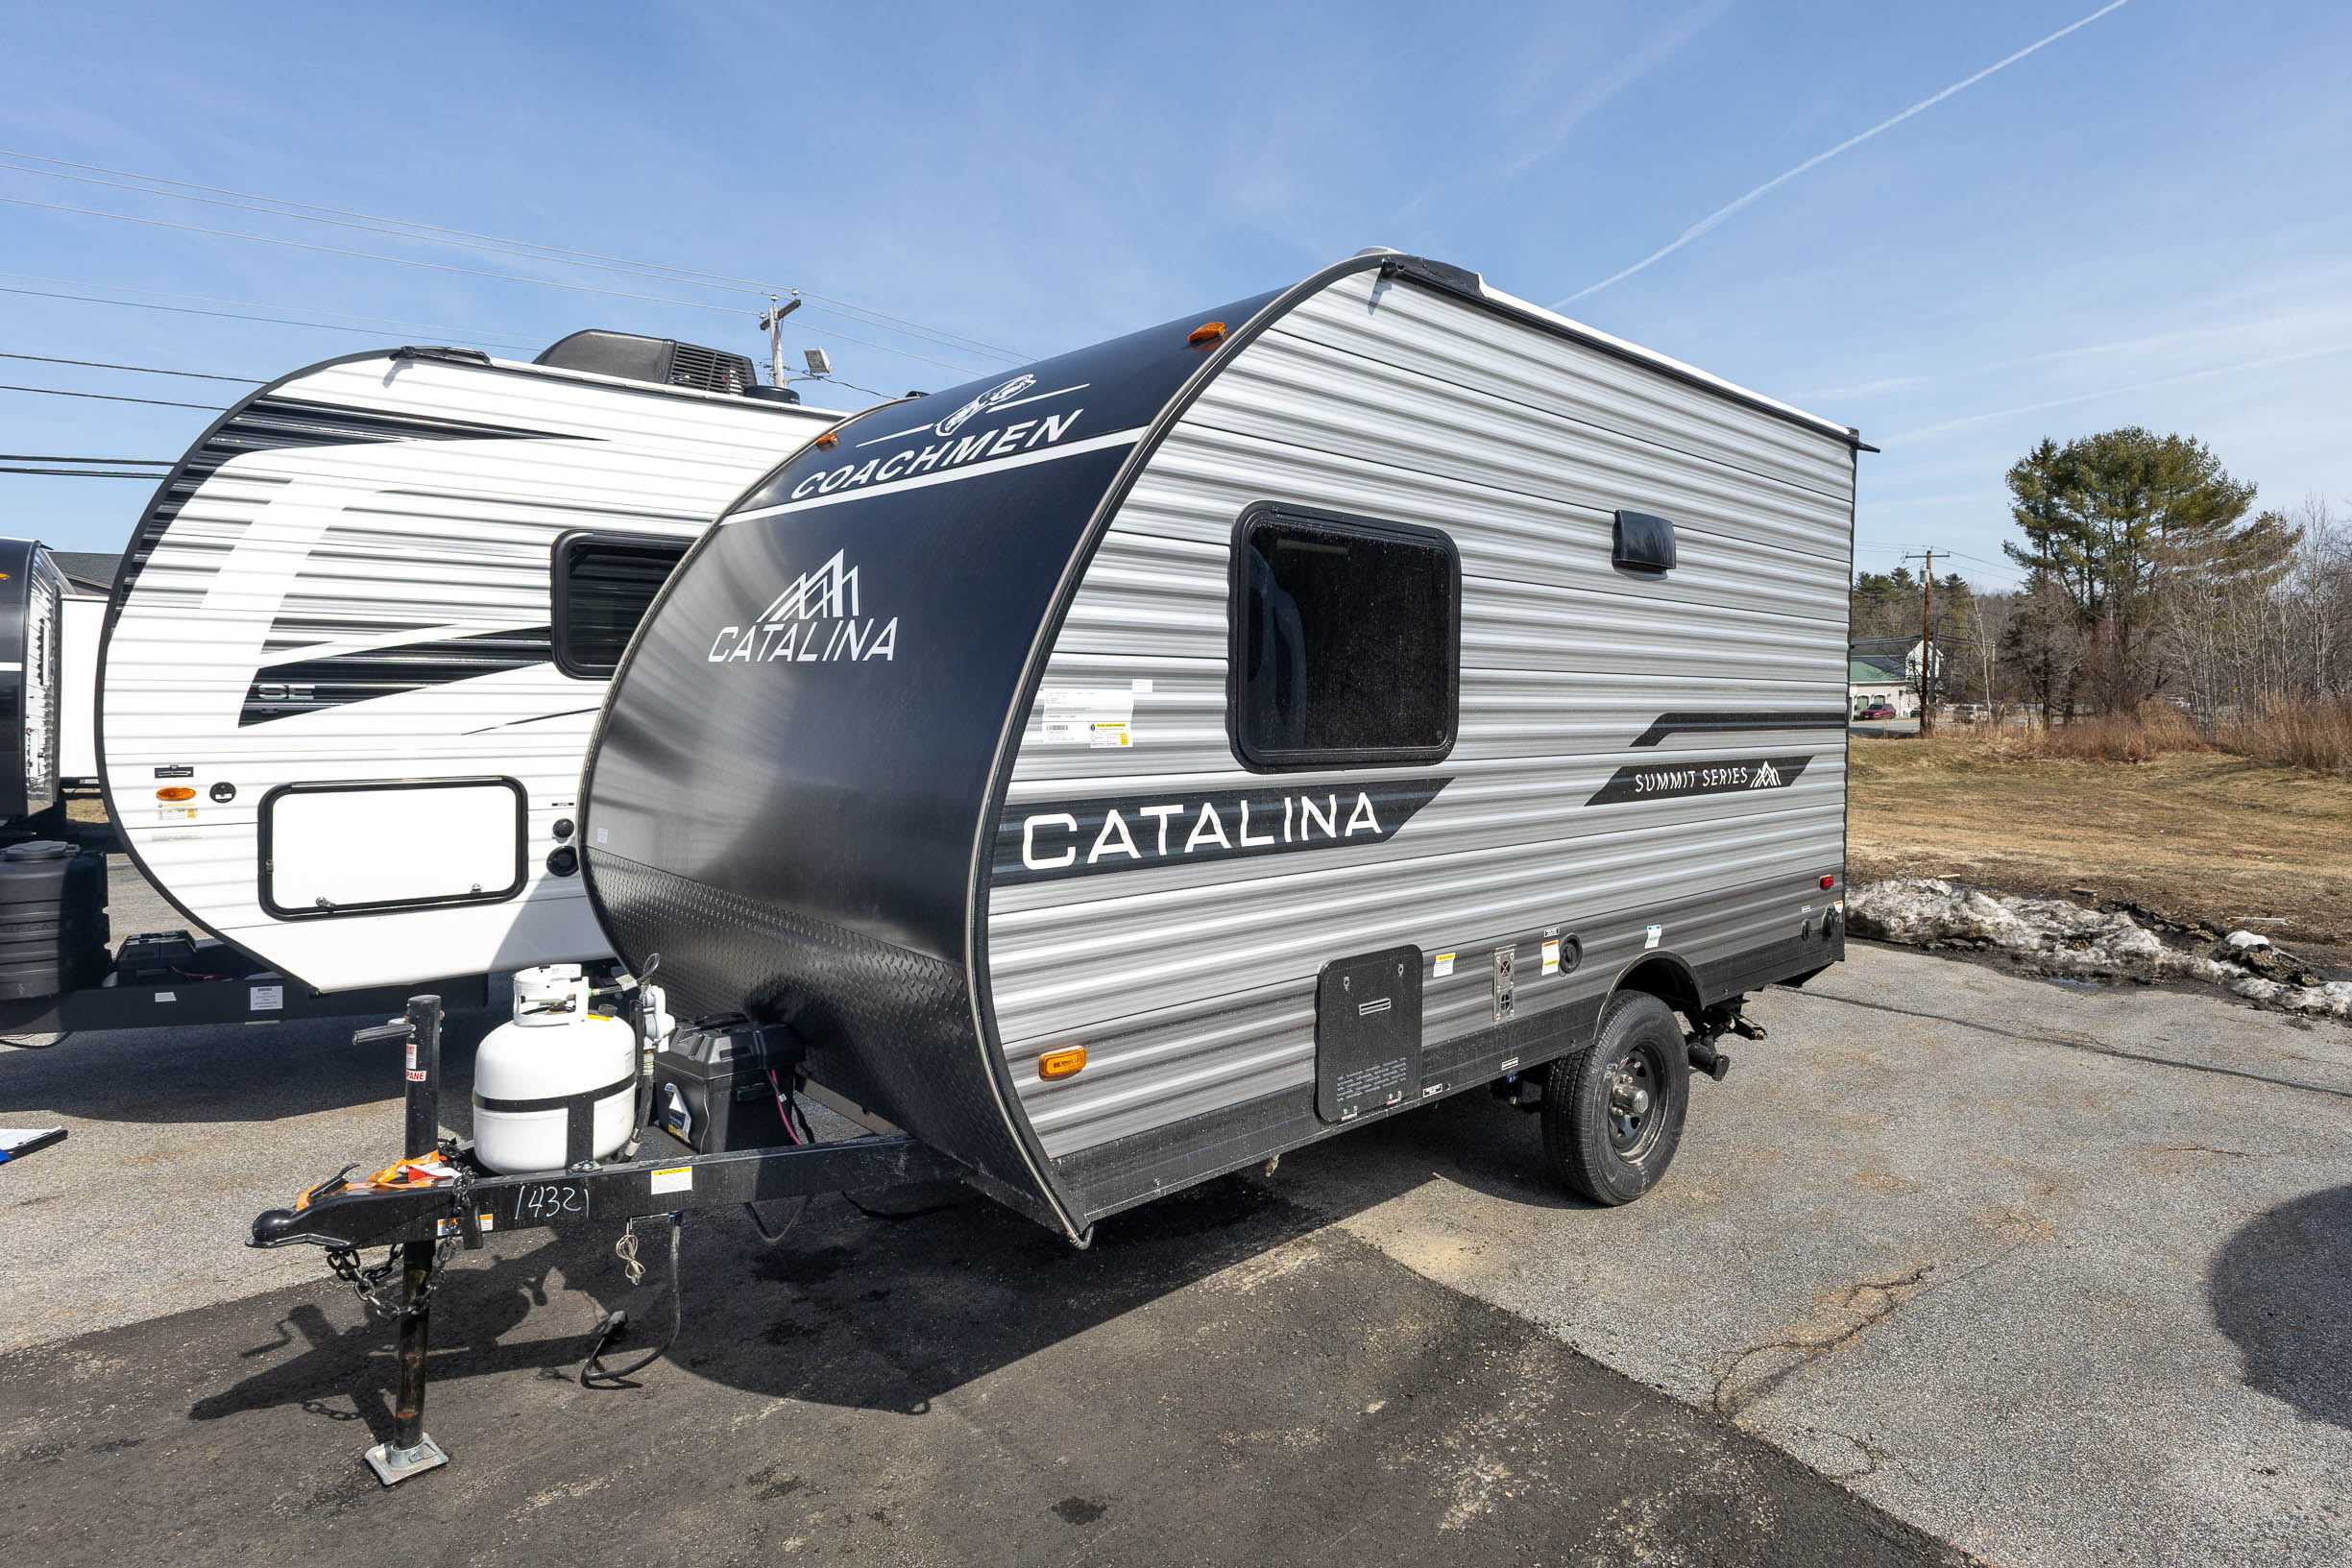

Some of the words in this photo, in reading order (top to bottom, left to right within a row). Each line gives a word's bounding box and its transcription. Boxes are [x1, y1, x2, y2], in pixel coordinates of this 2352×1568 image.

[790, 408, 1085, 500] COACHMEN
[707, 615, 899, 663] CATALINA
[1635, 770, 1696, 793] SUMMIT
[1702, 766, 1748, 787] SERIES
[1022, 791, 1383, 871] CATALINA
[514, 1184, 591, 1221] 14321
